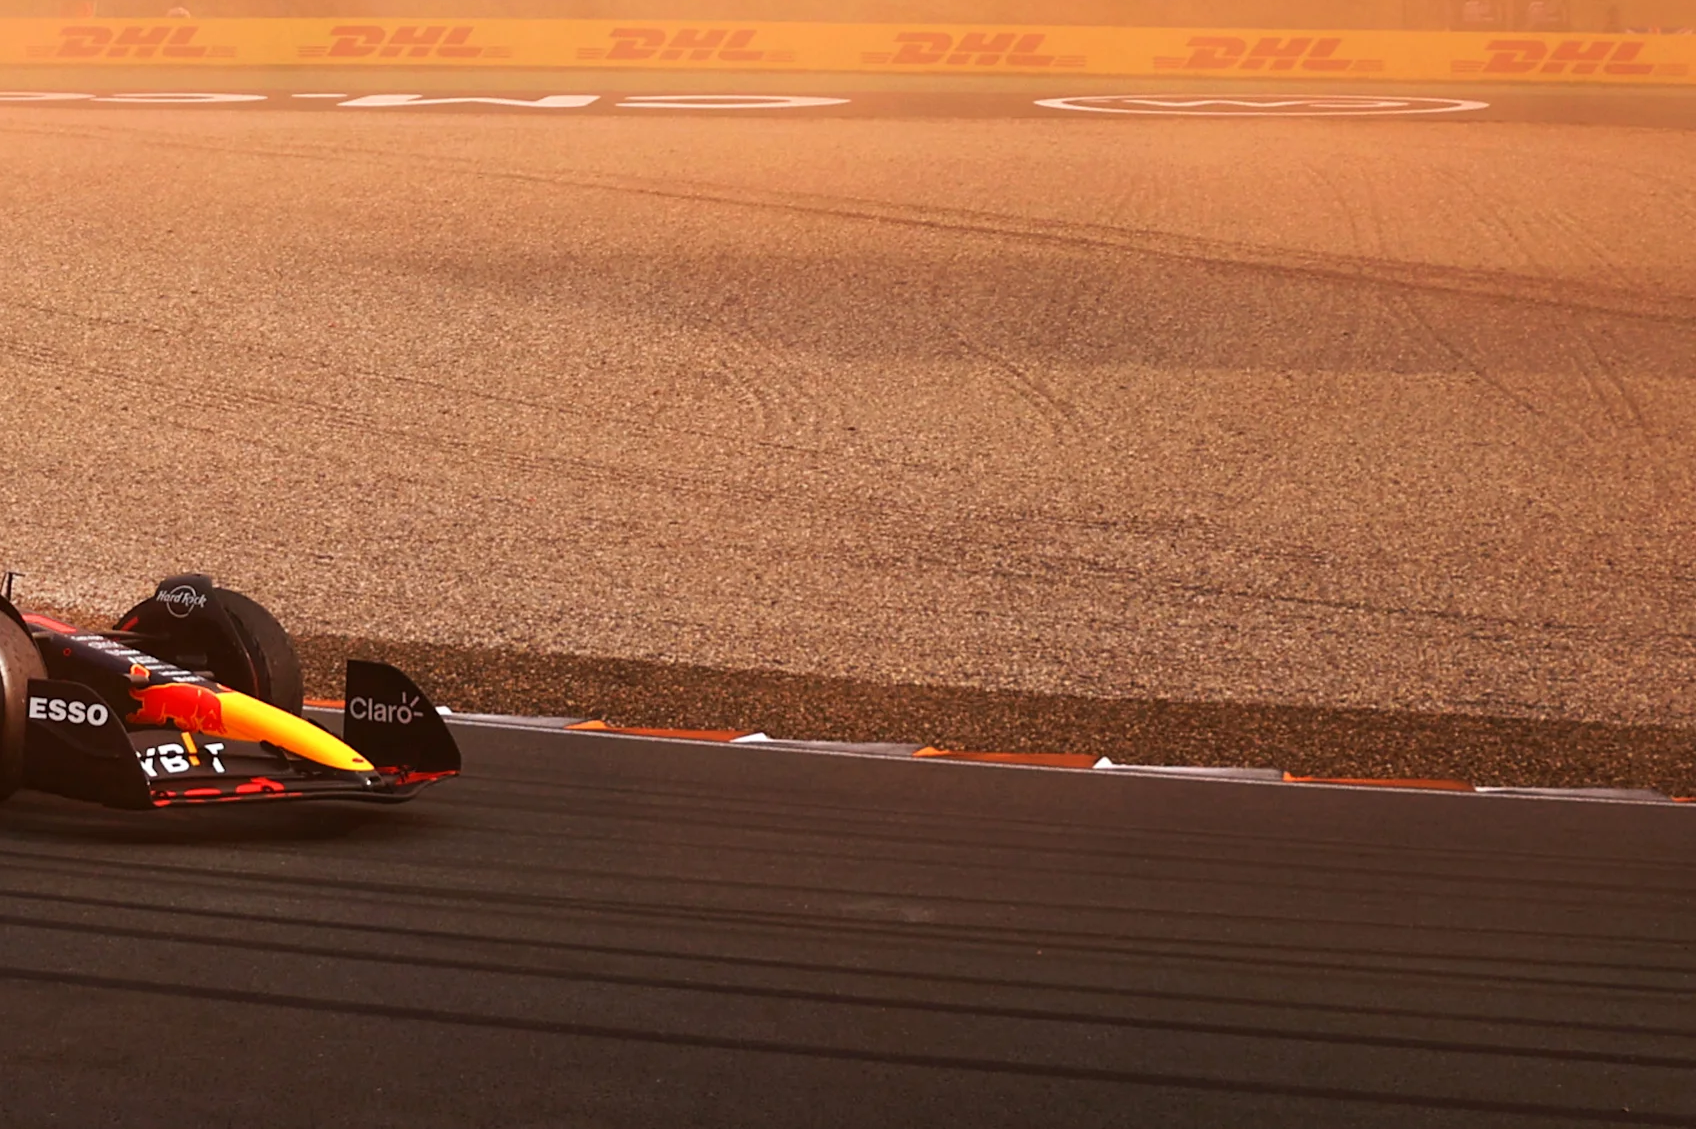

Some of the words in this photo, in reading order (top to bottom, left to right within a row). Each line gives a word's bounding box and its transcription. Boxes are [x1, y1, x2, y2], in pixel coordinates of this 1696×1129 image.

[56, 26, 206, 59] DHL
[326, 25, 484, 59] DHL
[605, 28, 765, 62] DHL
[892, 32, 1056, 66] DHL
[1183, 36, 1354, 71] DHL
[1482, 40, 1656, 75] DHL
[29, 696, 109, 726] ESSO
[350, 696, 413, 724] Claro
[135, 732, 226, 777] YBIT
